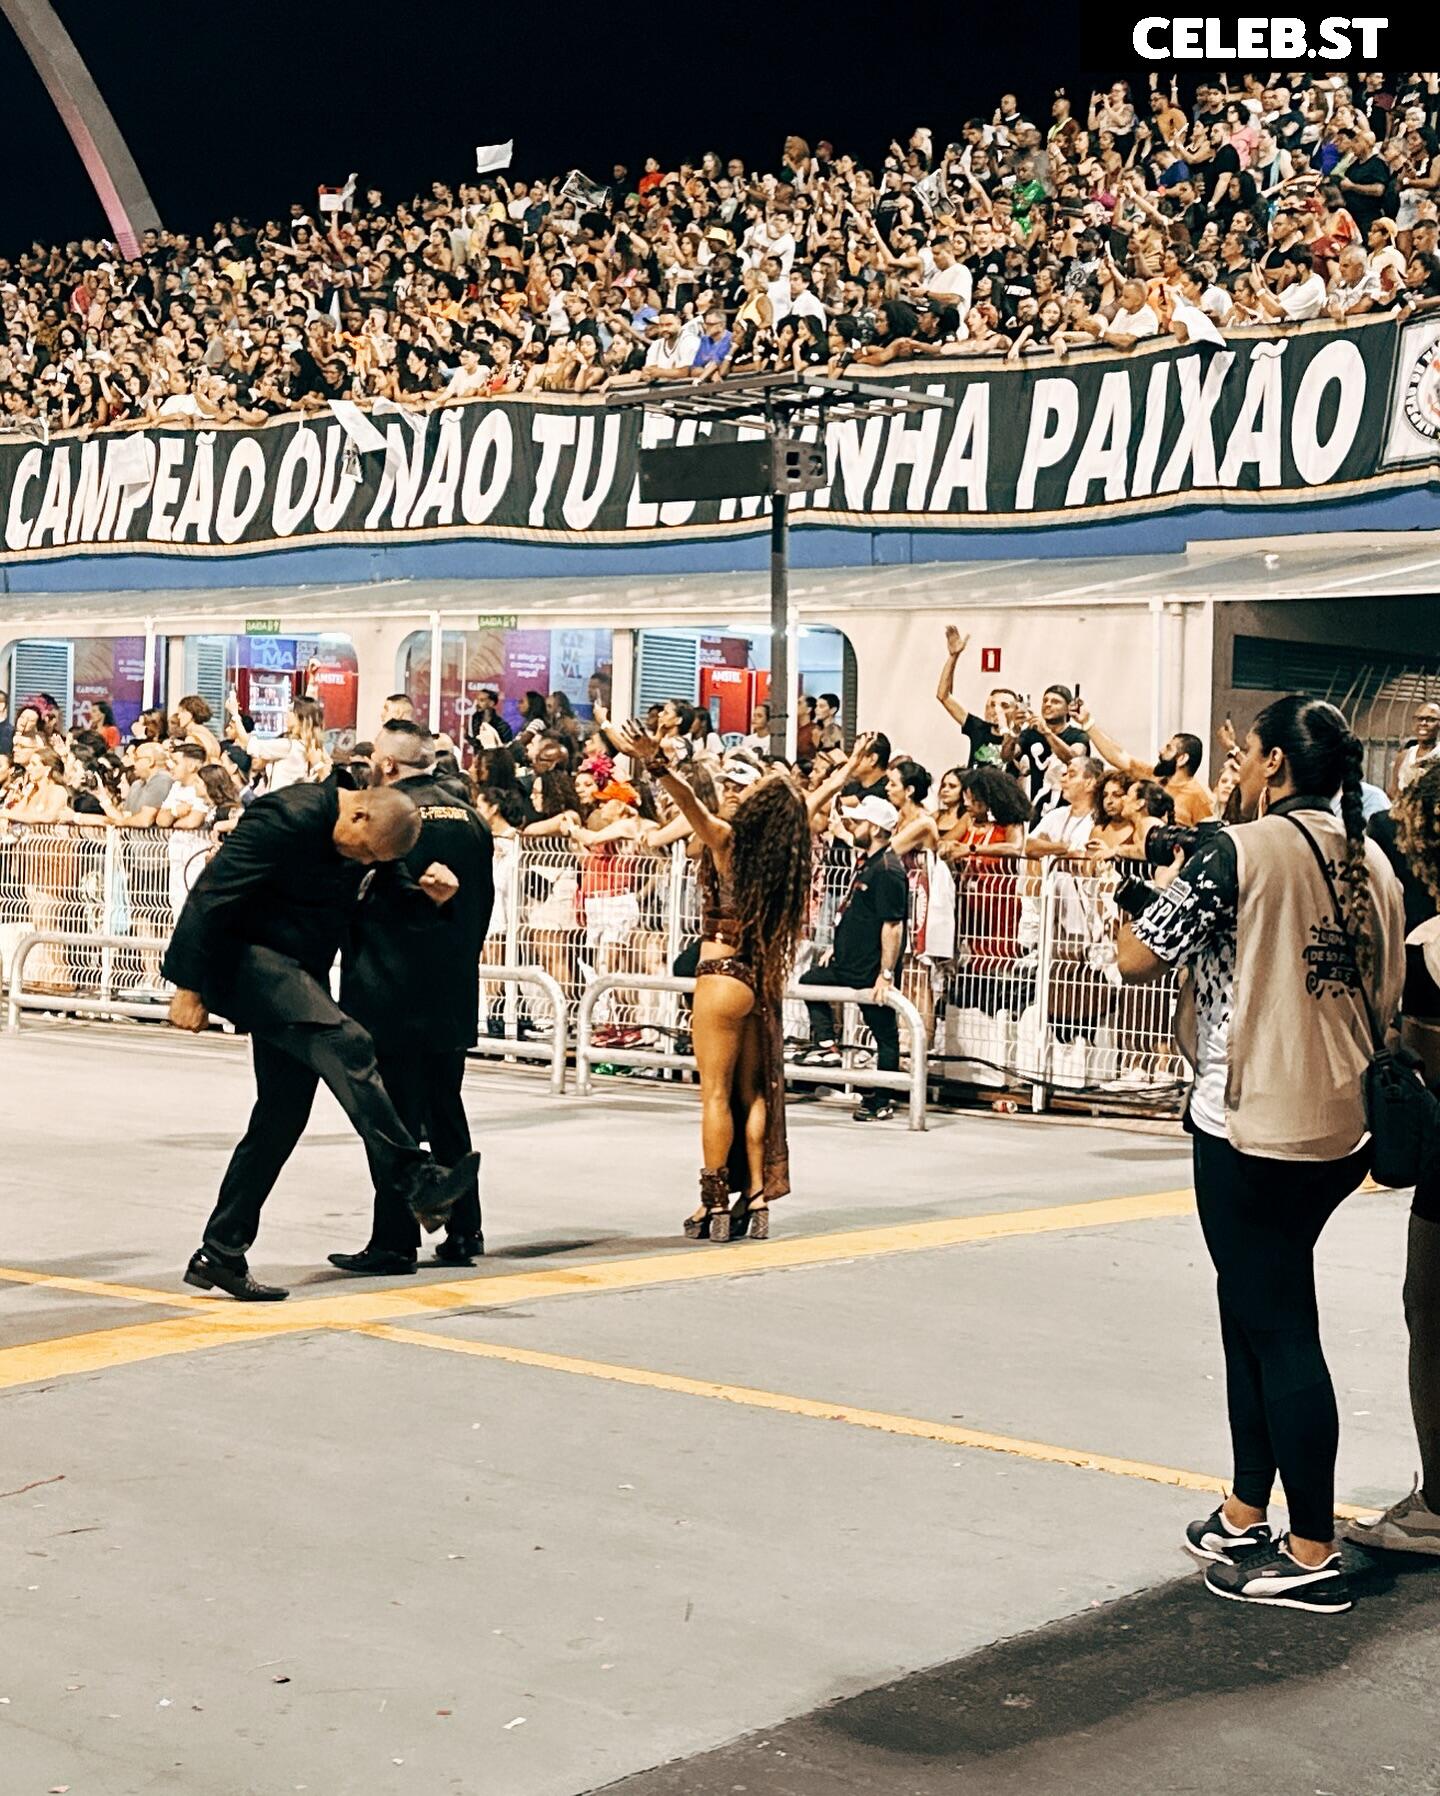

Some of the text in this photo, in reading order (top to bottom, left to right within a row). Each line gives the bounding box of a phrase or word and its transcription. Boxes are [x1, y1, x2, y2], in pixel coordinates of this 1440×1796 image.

[272, 425, 358, 537] OU
[364, 406, 513, 529] NÃO
[529, 413, 621, 530] TU
[1015, 339, 1366, 510] PAIXÃO
